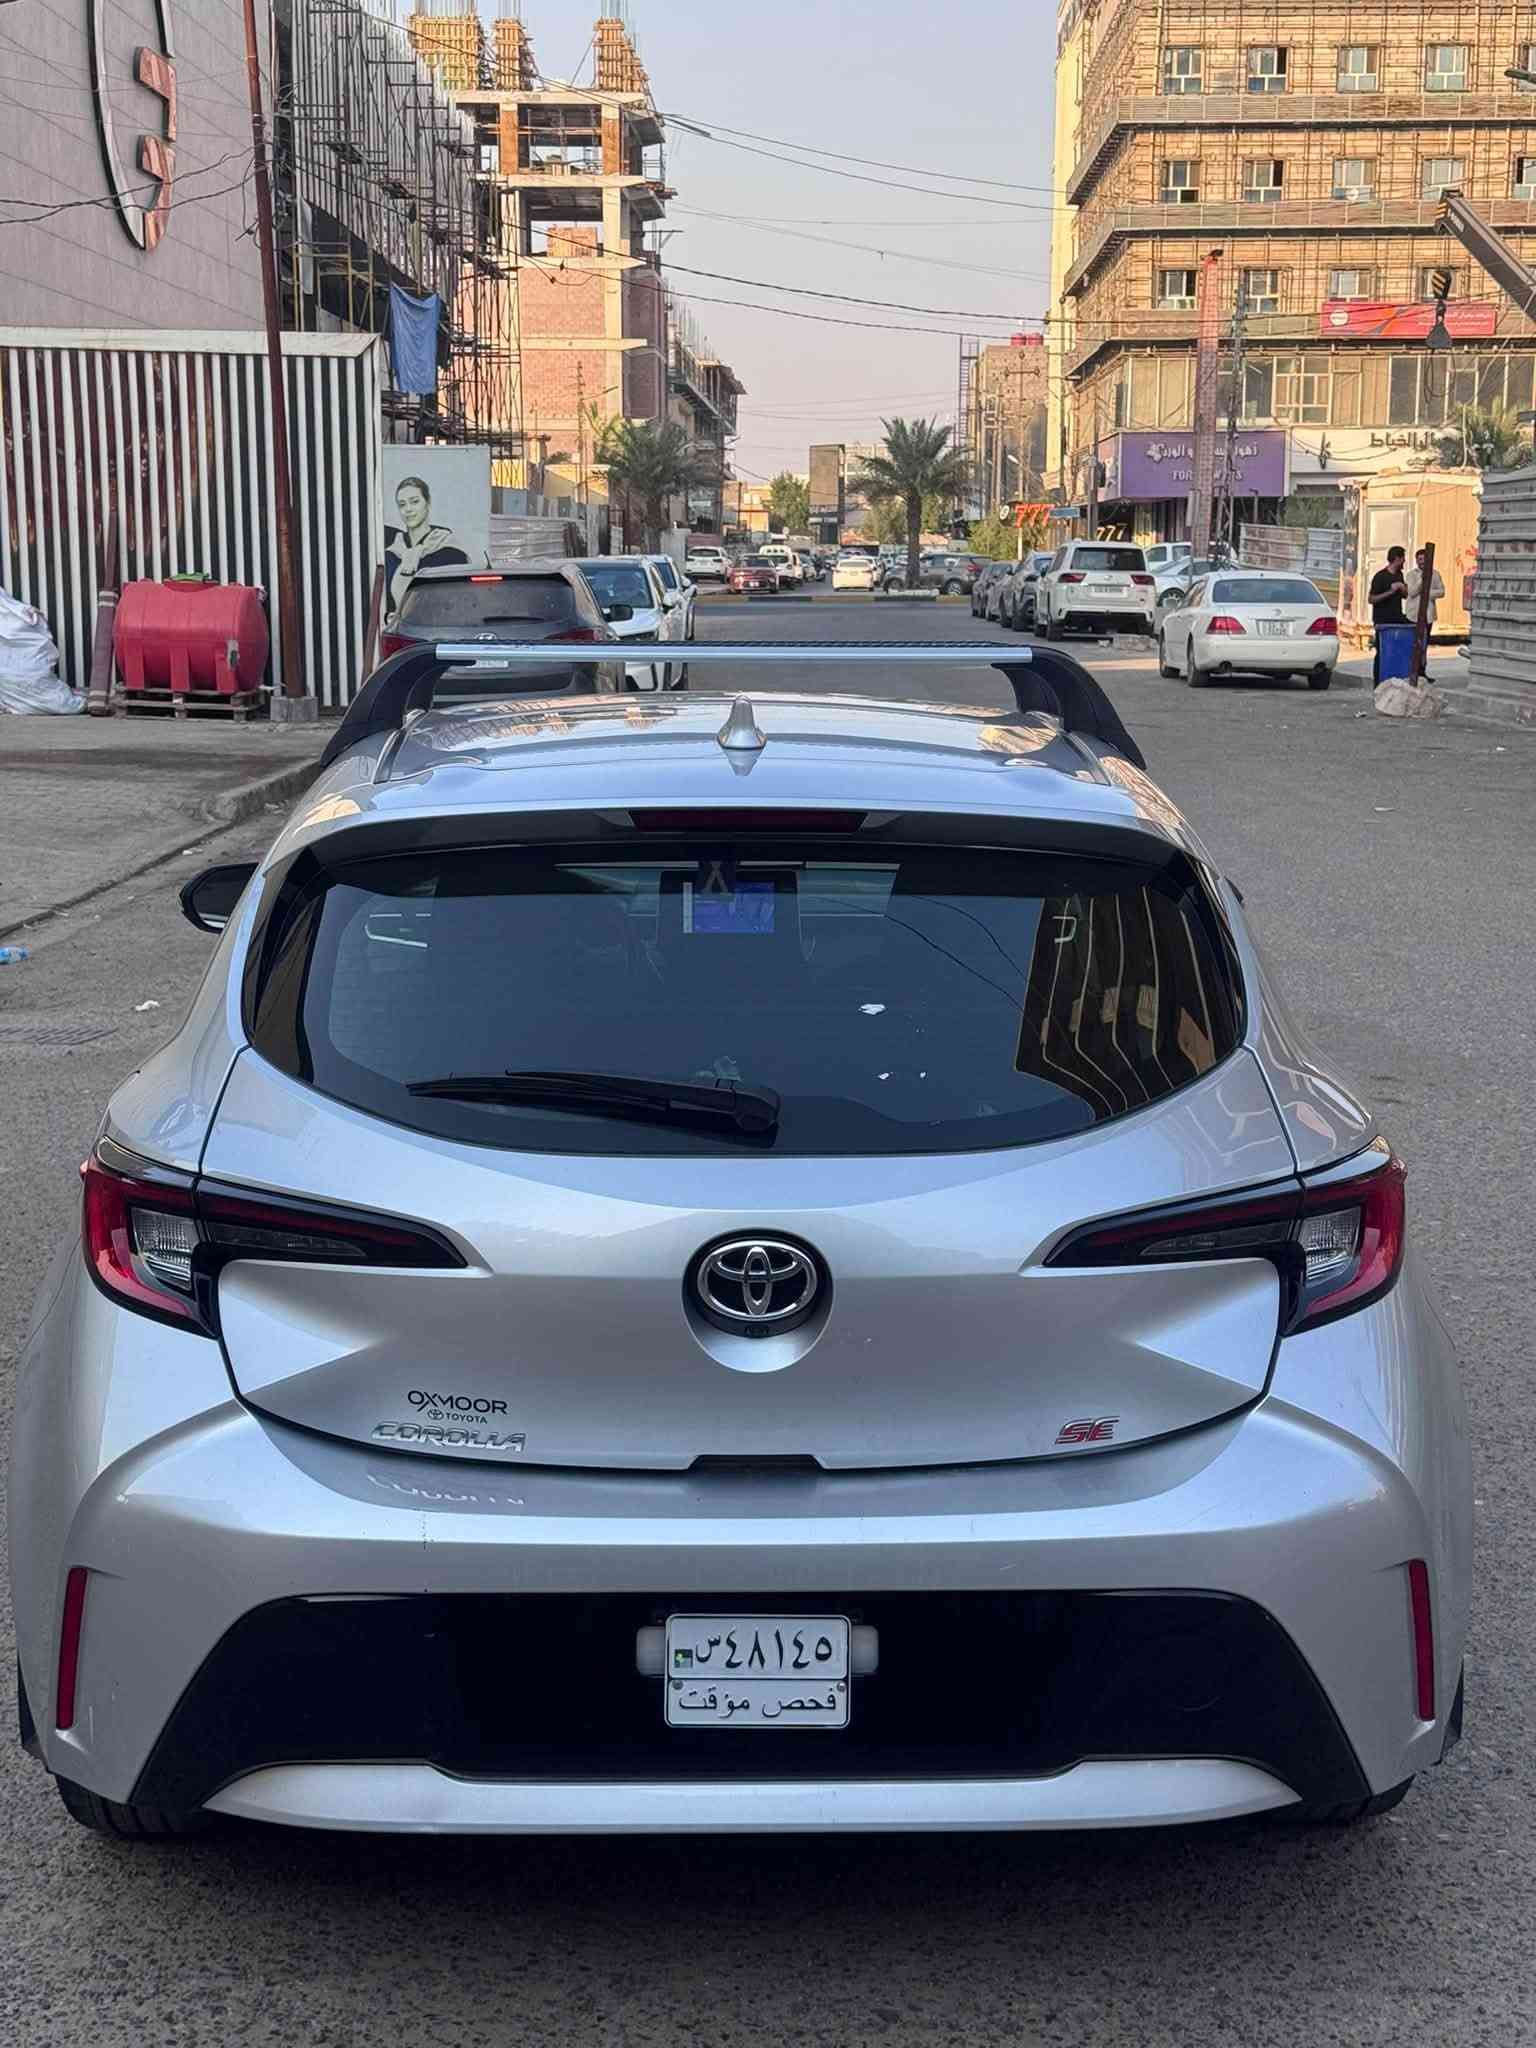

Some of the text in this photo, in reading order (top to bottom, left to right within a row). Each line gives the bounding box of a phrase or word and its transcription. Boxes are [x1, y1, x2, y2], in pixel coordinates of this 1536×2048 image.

[407, 1389, 508, 1415] OXMOOR
[445, 1412, 488, 1425] TOYOTA
[1055, 1415, 1121, 1445] SE
[371, 1420, 527, 1452] COROLLA
[761, 1687, 837, 1718] فحص
